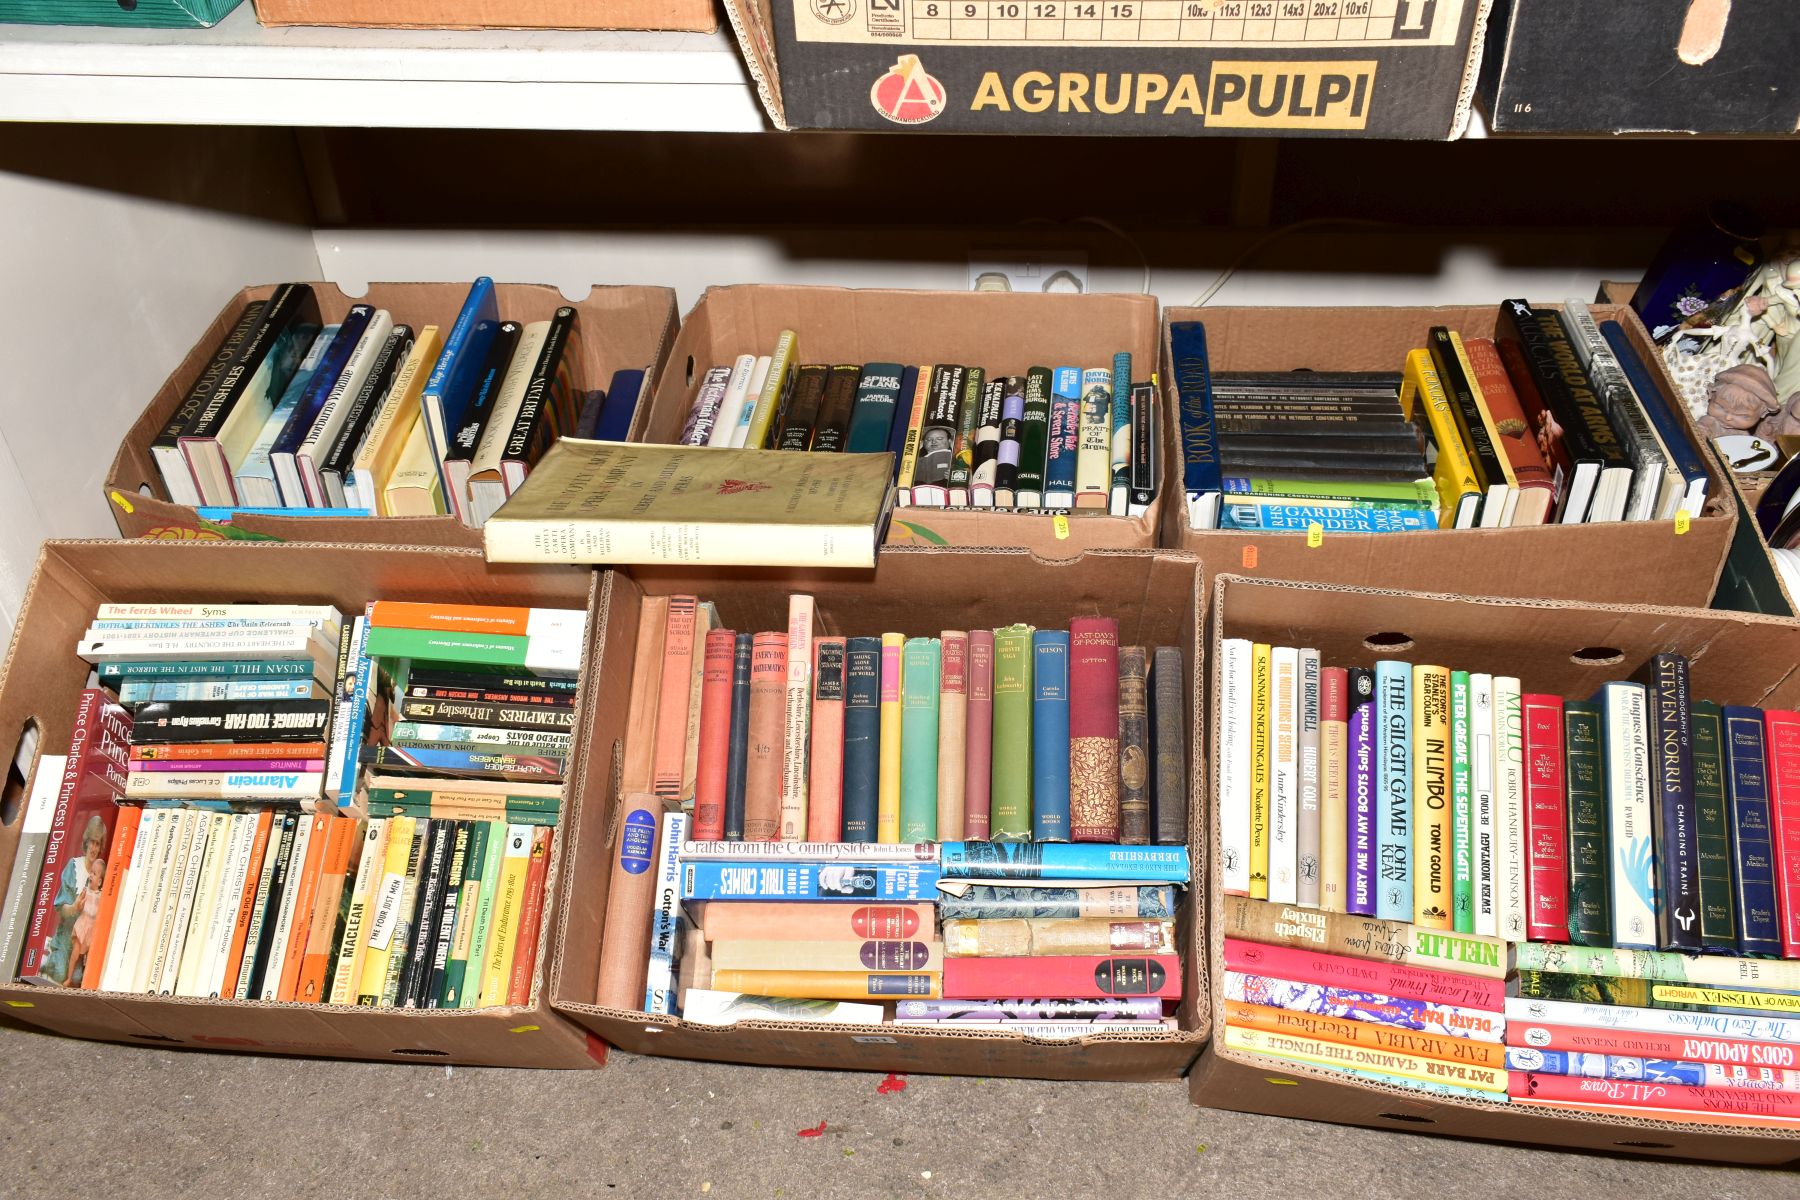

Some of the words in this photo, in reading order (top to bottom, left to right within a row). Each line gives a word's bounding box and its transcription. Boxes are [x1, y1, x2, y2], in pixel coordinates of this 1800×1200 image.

[926, 4, 938, 17] 8
[964, 4, 976, 17] 9
[997, 4, 1019, 18] 10
[1035, 4, 1056, 18] 12
[1074, 4, 1096, 18] 14
[1110, 4, 1133, 18] 15
[1220, 3, 1241, 17] 11x3
[1250, 3, 1272, 17] 12x3
[1283, 3, 1304, 16] 14x3
[1314, 2, 1337, 16] 20x2
[1345, 2, 1368, 15] 10x6
[877, 108, 917, 123] COSECHAMOS
[916, 110, 940, 123] CALIDAD
[1540, 314, 1565, 340] THE
[180, 405, 197, 421] 250
[193, 363, 225, 404] TOURS
[220, 345, 235, 362] OF
[229, 304, 264, 344] BRITAIN
[953, 368, 961, 377] The
[1554, 341, 1587, 386] WORLD
[940, 371, 951, 389] Alfred
[1180, 357, 1205, 394] ROAD
[195, 422, 208, 434] THE
[202, 383, 229, 422] BRITISH
[223, 365, 245, 388] ISLES
[519, 378, 546, 418] BRITAIN
[949, 378, 960, 400] Strange
[1570, 388, 1594, 407] AT
[937, 390, 947, 419] Hitchcock
[947, 400, 957, 414] Case
[1051, 410, 1064, 436] Severn
[1064, 402, 1079, 433] Berkeley
[1583, 406, 1616, 444] ARMS
[508, 420, 531, 455] GREAT
[1049, 438, 1062, 459] Shore
[1185, 422, 1215, 464] BOOK
[1049, 479, 1073, 487] HALE
[1270, 505, 1284, 527] RHS
[1284, 506, 1370, 519] GARDEN
[1373, 510, 1387, 530] 2003
[1388, 510, 1405, 531] 2004
[1284, 518, 1371, 531] FINDER
[108, 606, 126, 615] The
[129, 606, 157, 615] Ferris
[160, 606, 192, 615] Wheel
[201, 607, 226, 617] Syms
[127, 666, 158, 674] MIRROR
[160, 666, 175, 674] THE
[209, 665, 225, 673] THE
[232, 665, 260, 674] HILL
[263, 665, 304, 674] SUSAN
[1304, 658, 1317, 680] BEAU
[1390, 676, 1406, 710] THE
[1423, 673, 1431, 694] REAR
[1431, 673, 1439, 716] STANLEY'S
[1660, 660, 1677, 722] STEVEN
[77, 693, 94, 726] Prince
[1304, 682, 1317, 732] BRUMMELL
[1423, 695, 1431, 728] COLUMN
[1454, 684, 1466, 719] PETER
[1677, 676, 1686, 735] AUTOBIOGRAPHY
[171, 717, 188, 727] Ryan
[189, 716, 221, 726] Cornelius
[223, 714, 246, 730] FAR
[247, 713, 270, 729] TOO
[272, 712, 317, 728] BRIDGE
[317, 712, 326, 726] A
[1359, 705, 1369, 742] Trench
[1440, 714, 1446, 726] OF
[67, 728, 87, 770] Charles
[396, 741, 451, 751] GALSWORTHY
[538, 748, 566, 756] STRIFE
[1255, 713, 1265, 783] NIGHTINGALES
[1390, 714, 1407, 776] GILGIT
[1426, 738, 1445, 755] IN
[1454, 719, 1467, 764] GREAVE
[1681, 737, 1687, 747] OF
[1303, 746, 1317, 784] HUBERT
[1357, 743, 1370, 772] Sally
[1663, 729, 1681, 793] NORRIS
[65, 771, 76, 780] &
[227, 775, 299, 788] Alamein
[1426, 756, 1445, 810] LIMBO
[1456, 771, 1468, 795] THE
[54, 782, 75, 828] Princess
[1254, 788, 1264, 822] Nicolette
[1303, 785, 1316, 811] COLE
[1357, 773, 1369, 814] BOOTS
[1390, 778, 1406, 836] GAME
[669, 817, 682, 844] John
[1075, 828, 1115, 836] NISBET
[1357, 815, 1369, 838] MY
[1456, 796, 1469, 848] SEVENTH
[1676, 804, 1686, 857] CHANGING
[457, 828, 468, 850] JACK
[1254, 823, 1263, 847] Devas
[1357, 839, 1368, 850] IN
[1430, 823, 1441, 851] TONY
[46, 830, 65, 864] Diana
[683, 841, 726, 856] Crafts
[728, 840, 759, 854] from
[761, 840, 784, 854] the
[786, 841, 871, 857] Countryside
[1109, 851, 1179, 861] DERBYSHIRE
[449, 852, 464, 886] HIGGINS
[666, 845, 678, 883] Harris
[1357, 852, 1368, 871] ME
[1380, 843, 1394, 880] KEAY
[1393, 843, 1406, 882] JOHN
[1430, 852, 1441, 893] GOULD
[1456, 849, 1469, 881] GATE
[38, 871, 54, 906] Michèle
[1357, 872, 1368, 905] BURY
[1679, 861, 1688, 896] TRAINS
[447, 893, 457, 908] THE
[662, 888, 674, 928] Cotton's
[31, 908, 48, 937] Brown
[439, 908, 455, 941] VIOLENT
[1280, 907, 1327, 929] Huxley
[343, 903, 364, 958] MACLEAN
[658, 930, 669, 953] War
[1274, 922, 1326, 943] Elspeth
[434, 942, 447, 970] ENEMY
[1415, 931, 1499, 968] NELLIE
[1276, 1013, 1318, 1033] Brent
[1318, 1021, 1359, 1041] Peter
[1267, 1036, 1324, 1055] JUNGLE
[1325, 1046, 1353, 1061] THE
[1374, 1030, 1448, 1056] ARABIA
[1452, 1043, 1489, 1063] FAR
[1682, 1039, 1749, 1060] APOLOGY
[1752, 1044, 1793, 1065] GOD'S
[1355, 1050, 1418, 1071] TAMING
[1425, 1062, 1466, 1078] BARR
[1466, 1068, 1495, 1083] PAT
